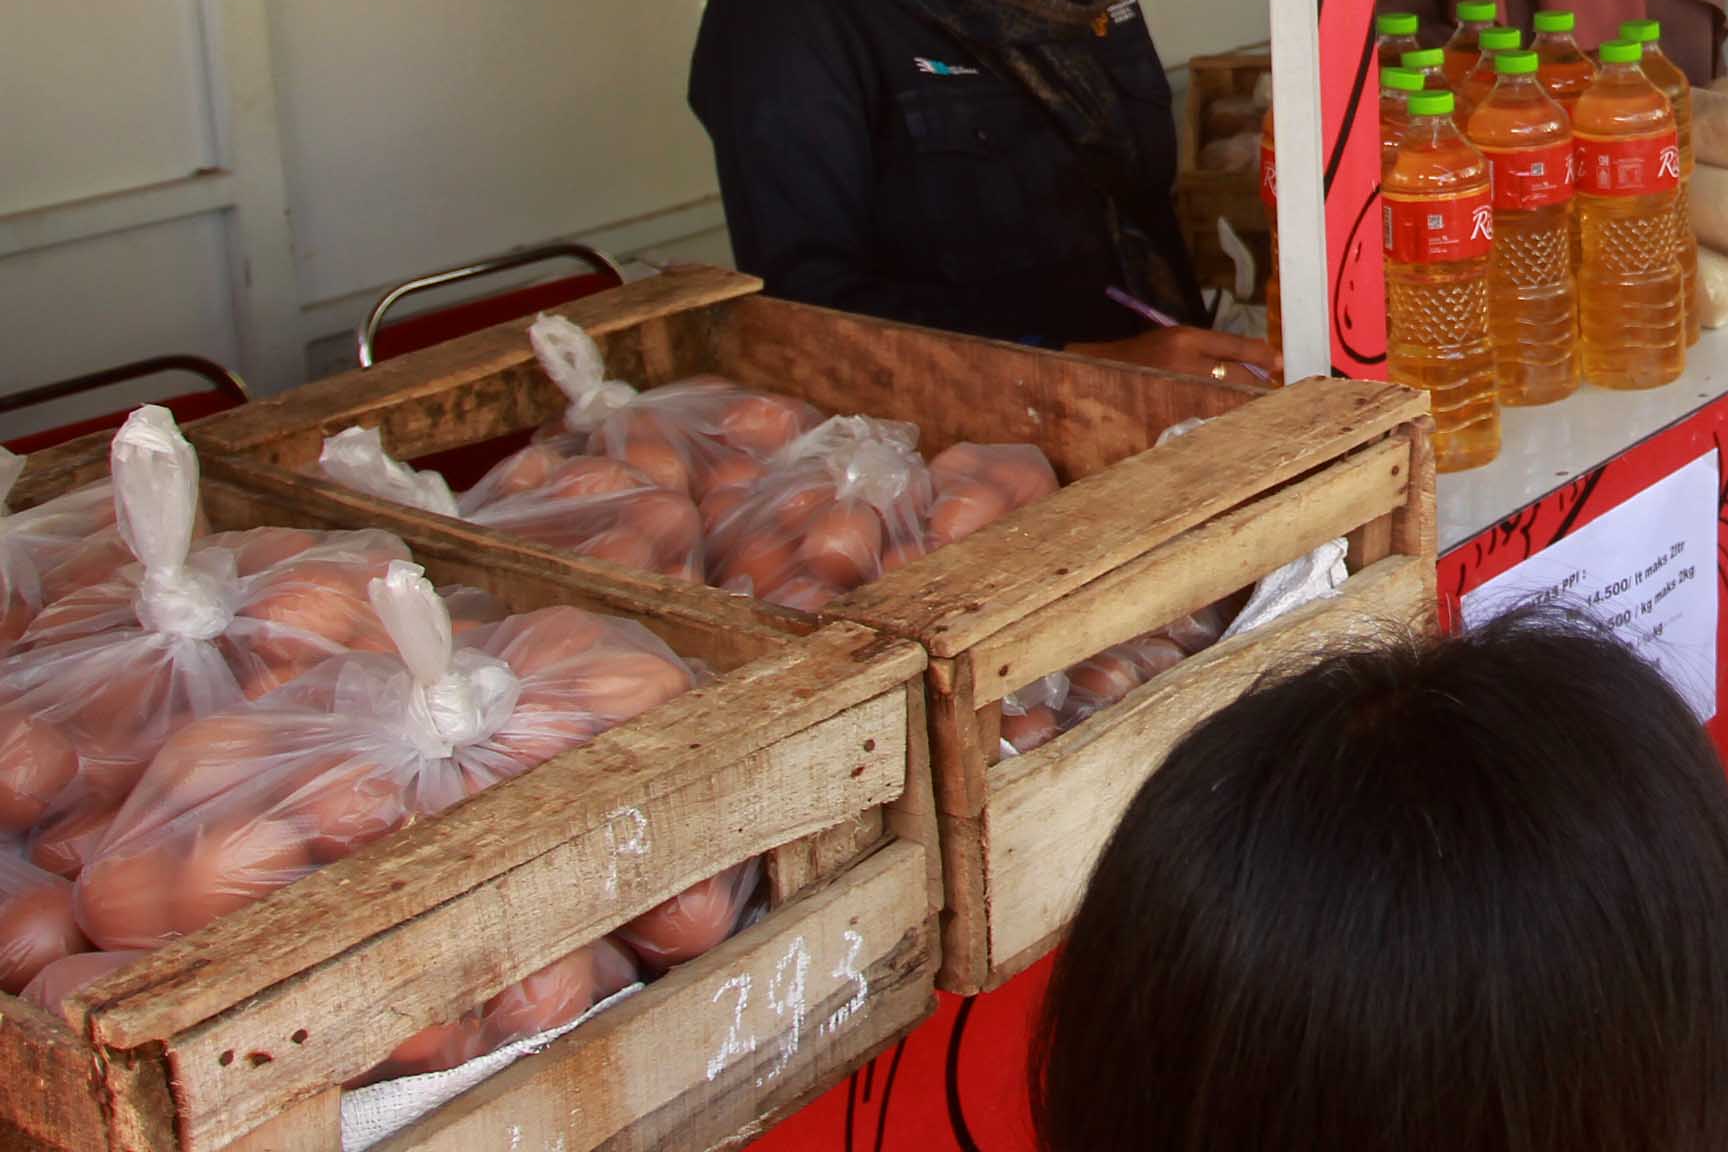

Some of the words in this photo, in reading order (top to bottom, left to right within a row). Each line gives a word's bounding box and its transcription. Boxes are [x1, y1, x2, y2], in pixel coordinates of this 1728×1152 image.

[1645, 556, 1668, 580] maks
[1641, 599, 1653, 616] kg
[1655, 581, 1676, 604] maks
[1679, 565, 1696, 584] 2kg
